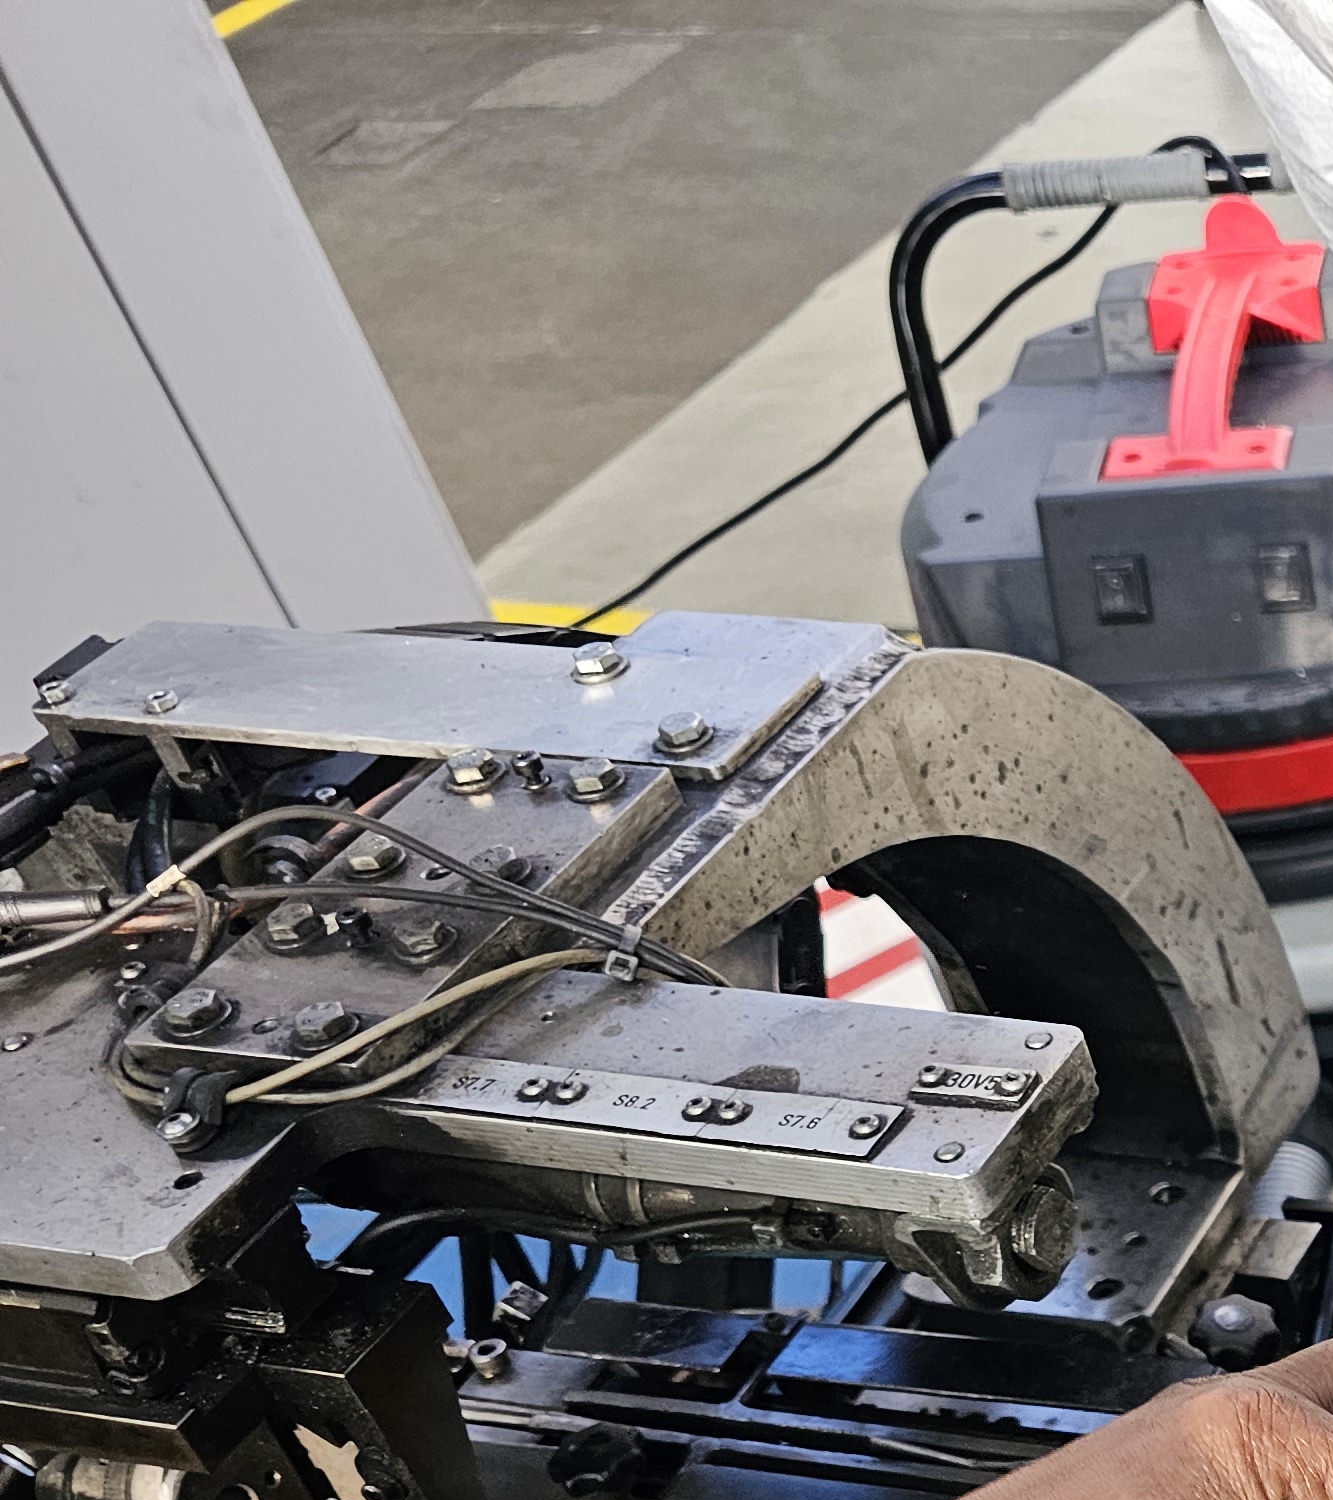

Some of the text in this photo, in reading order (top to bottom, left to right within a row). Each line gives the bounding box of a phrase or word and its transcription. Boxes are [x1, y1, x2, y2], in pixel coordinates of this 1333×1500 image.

[452, 1075, 497, 1092] S7.7
[612, 1094, 657, 1111] S8.2
[778, 1113, 822, 1130] S7.6
